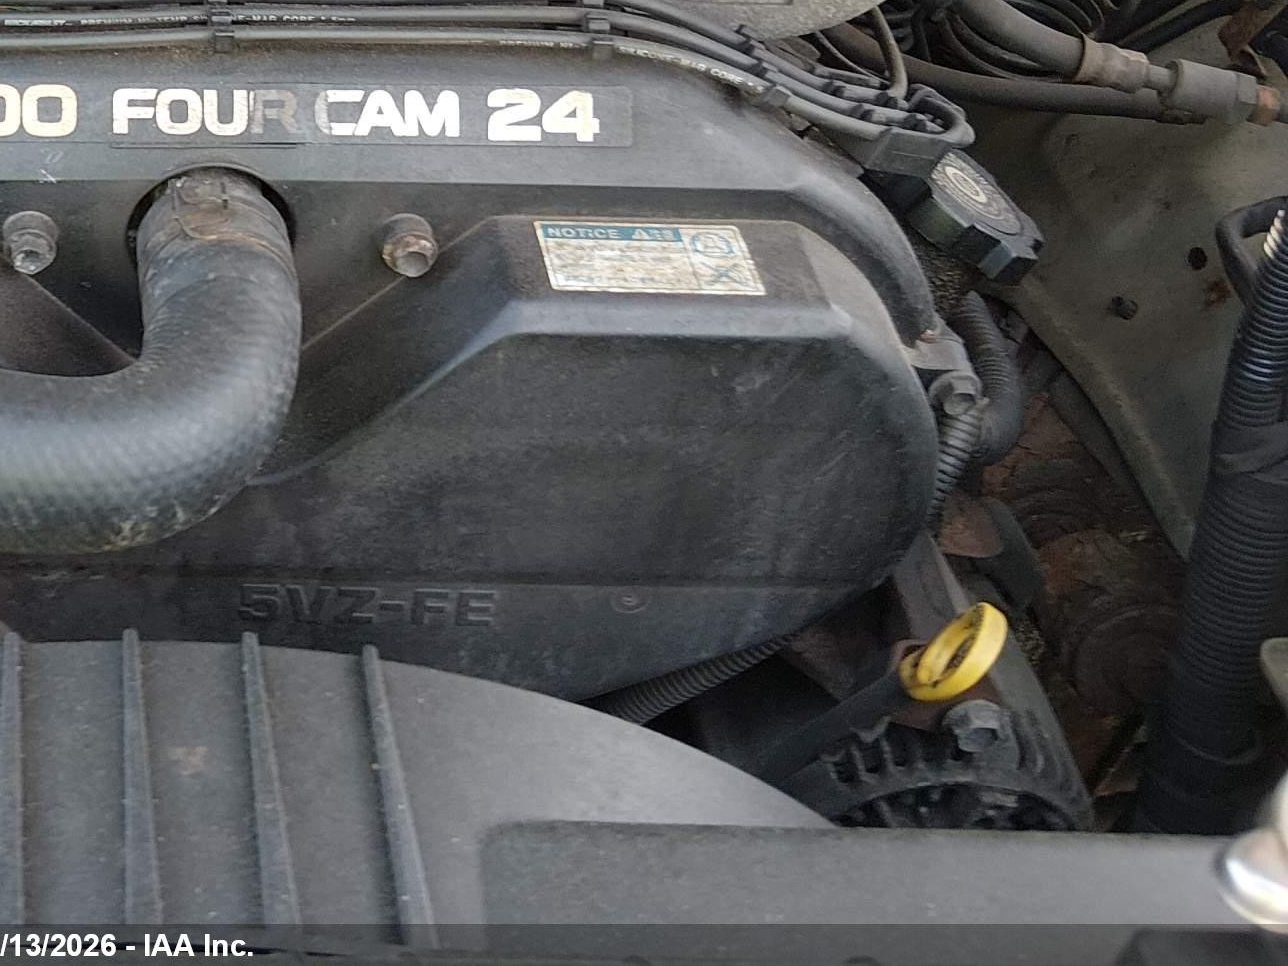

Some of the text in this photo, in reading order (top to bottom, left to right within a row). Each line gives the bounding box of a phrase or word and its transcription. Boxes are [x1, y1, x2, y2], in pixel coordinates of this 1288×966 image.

[111, 87, 298, 136] FOUR
[314, 88, 461, 138] CAM
[486, 87, 600, 142] 24
[546, 226, 622, 240] NOTICE
[239, 584, 500, 627] 5VZ-FE
